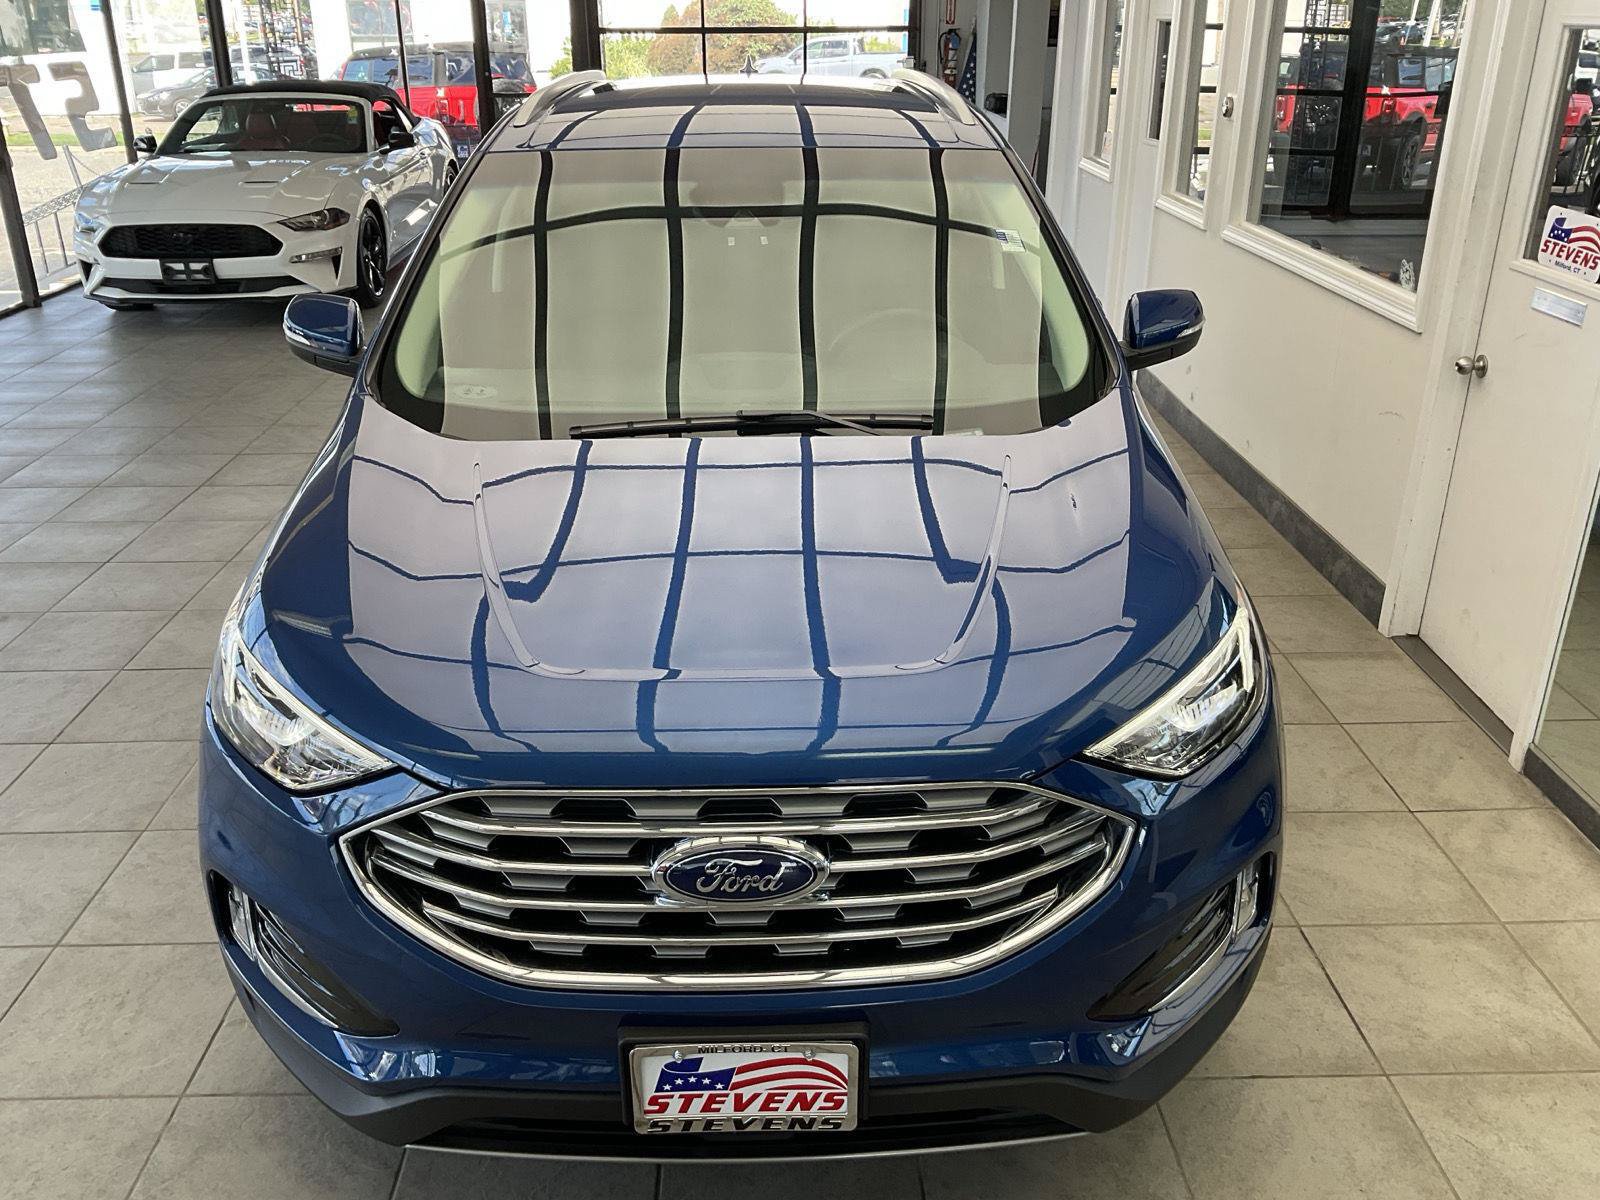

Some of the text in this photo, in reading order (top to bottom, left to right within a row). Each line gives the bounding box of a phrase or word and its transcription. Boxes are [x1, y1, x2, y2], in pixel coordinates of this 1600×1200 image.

[1541, 239, 1600, 271] STEVENS
[696, 858, 795, 893] Ford
[771, 1043, 791, 1053] CT
[644, 1092, 848, 1114] STEVENS
[647, 1116, 846, 1132] STEVENS
